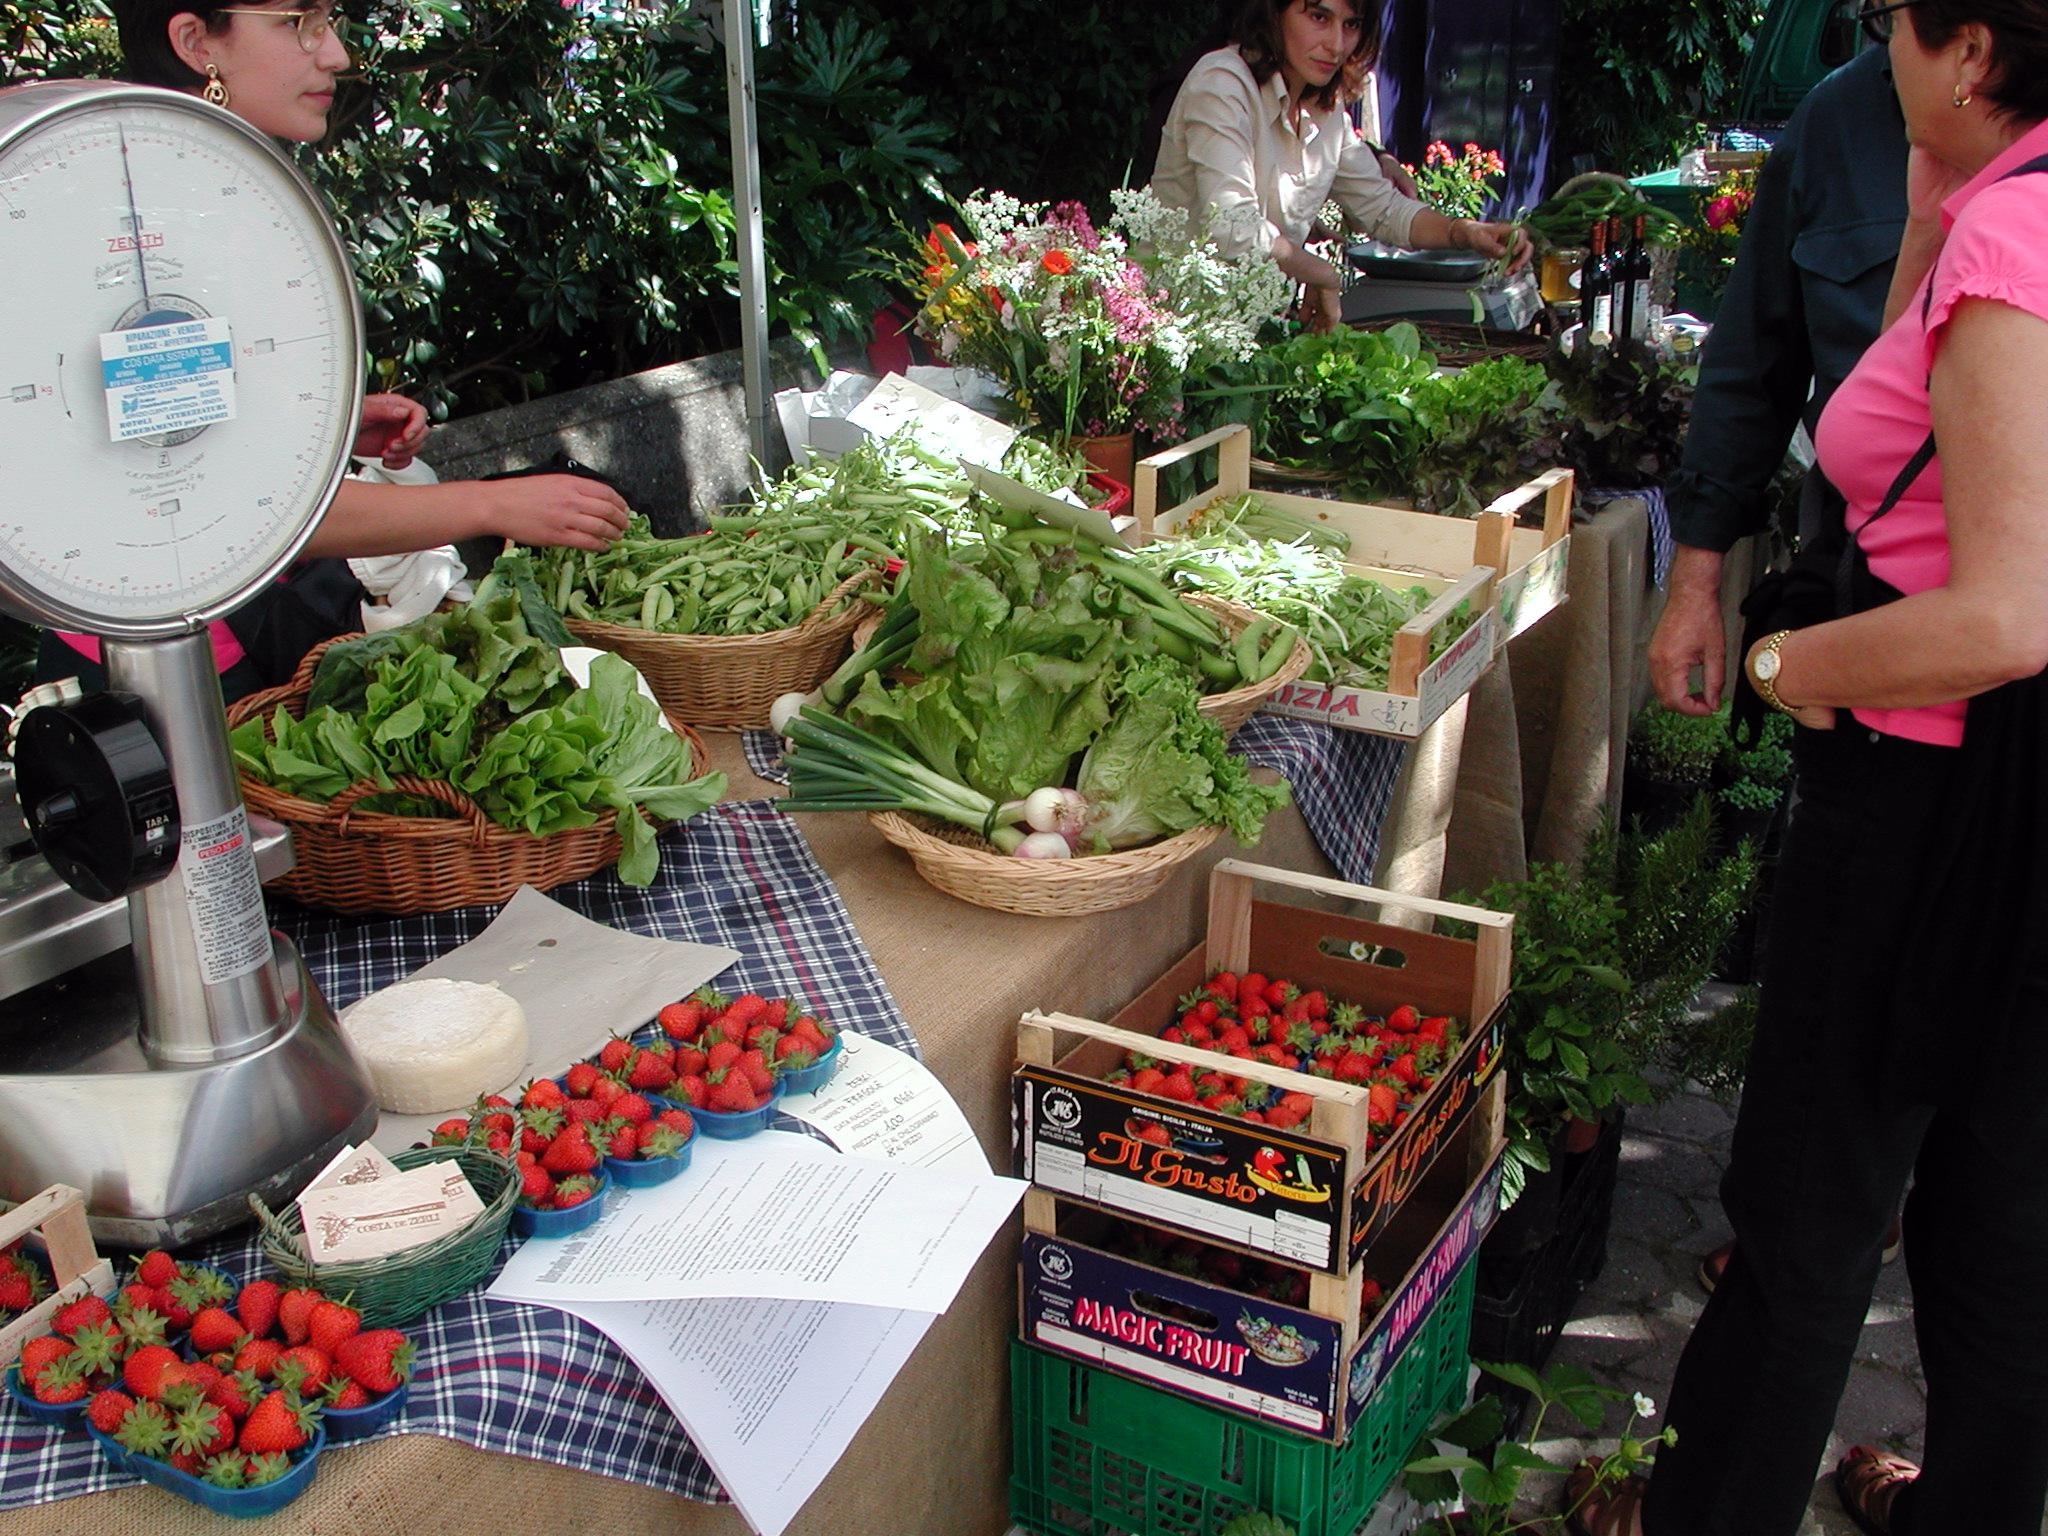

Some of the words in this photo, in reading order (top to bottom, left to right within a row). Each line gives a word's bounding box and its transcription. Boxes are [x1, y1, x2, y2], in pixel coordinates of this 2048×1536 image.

[106, 233, 164, 252] ZENITH
[145, 815, 170, 829] TARA
[200, 846, 224, 858] PESO
[1049, 1086, 1073, 1098] ITALIA
[1162, 1114, 1187, 1127] SICILIA
[1191, 1121, 1213, 1134] ITALIA
[1393, 1074, 1469, 1204] Gusto
[1144, 1149, 1257, 1203] Gusto
[357, 1221, 392, 1233] COSTA
[408, 1213, 441, 1226] ZERLI
[1388, 1254, 1437, 1353] MAGIC
[1433, 1202, 1475, 1290] FRUIT
[1041, 1311, 1071, 1328] SICILIA
[1073, 1296, 1163, 1353] MAGIC
[1163, 1325, 1250, 1377] FRUIT
